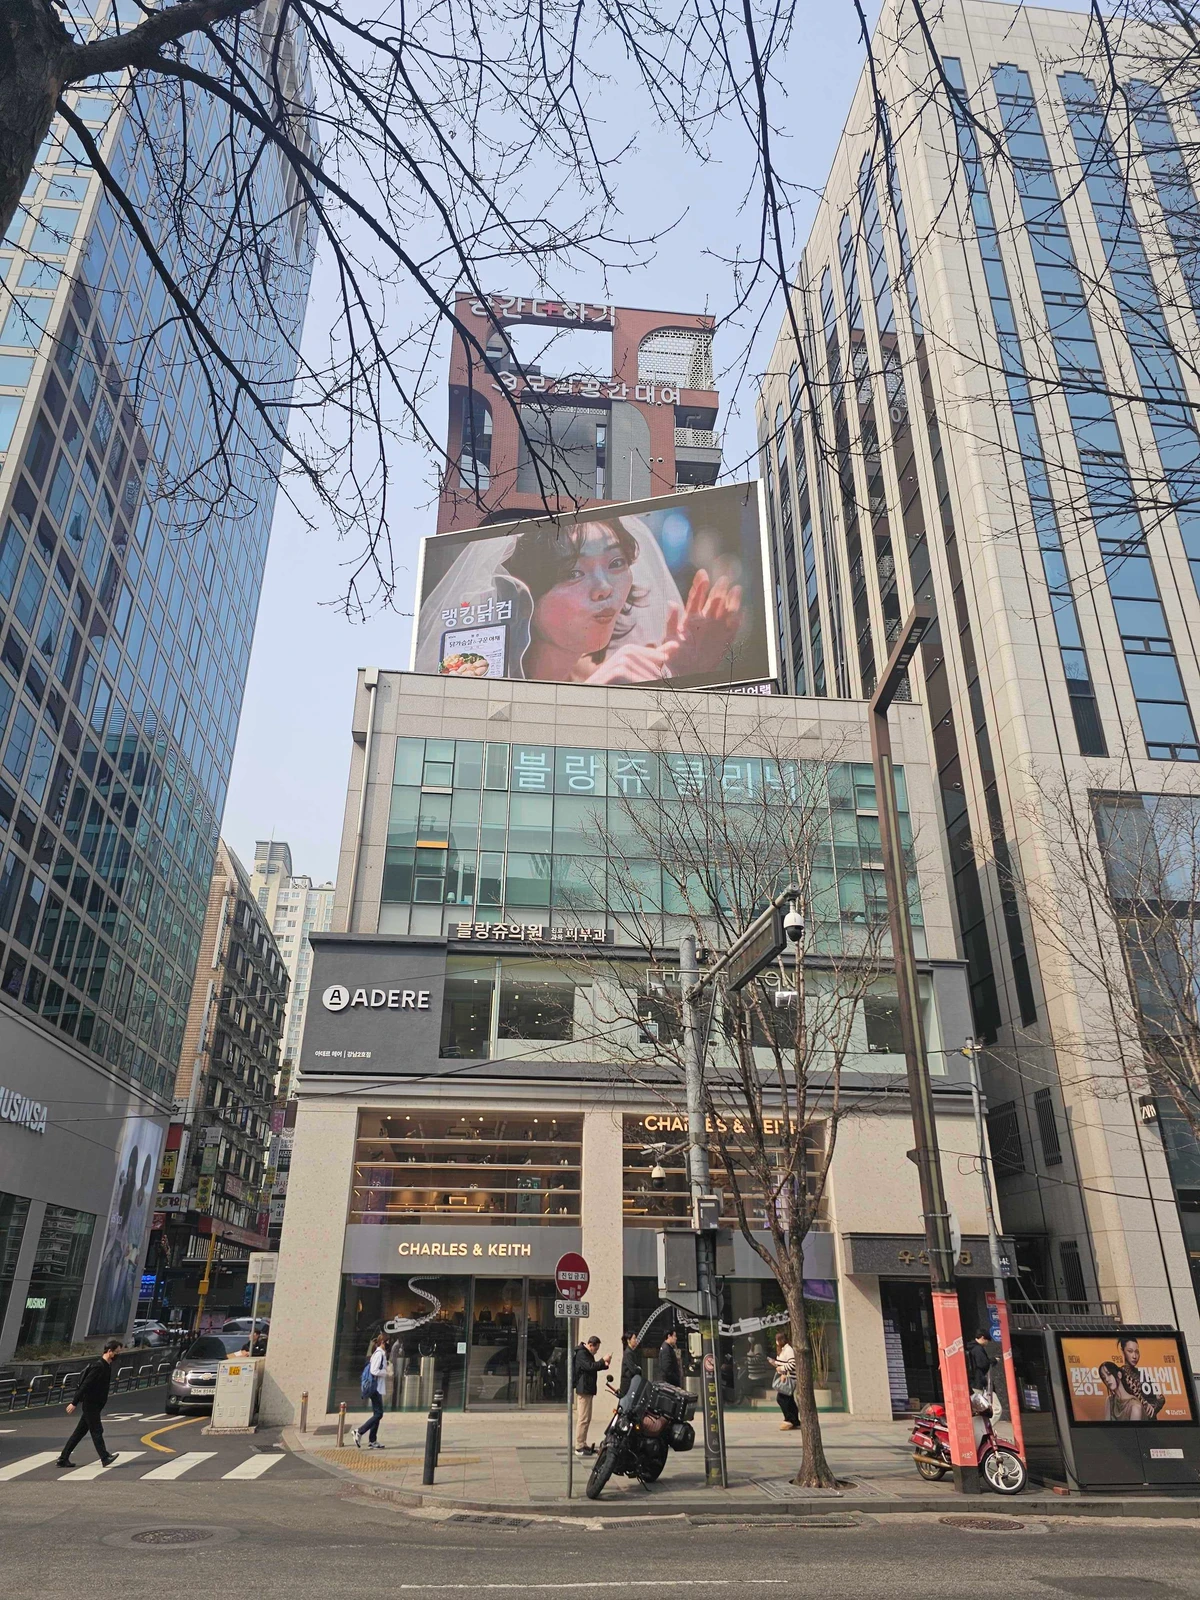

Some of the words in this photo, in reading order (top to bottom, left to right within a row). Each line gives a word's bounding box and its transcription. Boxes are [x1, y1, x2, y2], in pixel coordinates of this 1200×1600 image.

[441, 597, 512, 628] 랭킹닭컴
[514, 751, 651, 794] 블랑쥬
[672, 760, 797, 802] 클리닉
[456, 920, 543, 941] 블랑쥬의원
[565, 927, 607, 943] 피부과
[351, 988, 430, 1009] ADERE
[733, 1118, 746, 1134] &
[398, 1242, 468, 1256] CHARLES
[472, 1243, 483, 1256] &
[488, 1243, 531, 1256] KEITH
[561, 1272, 586, 1280] 진입금지
[25, 1297, 47, 1309] MUSINSA
[557, 1303, 588, 1316] 일방통행
